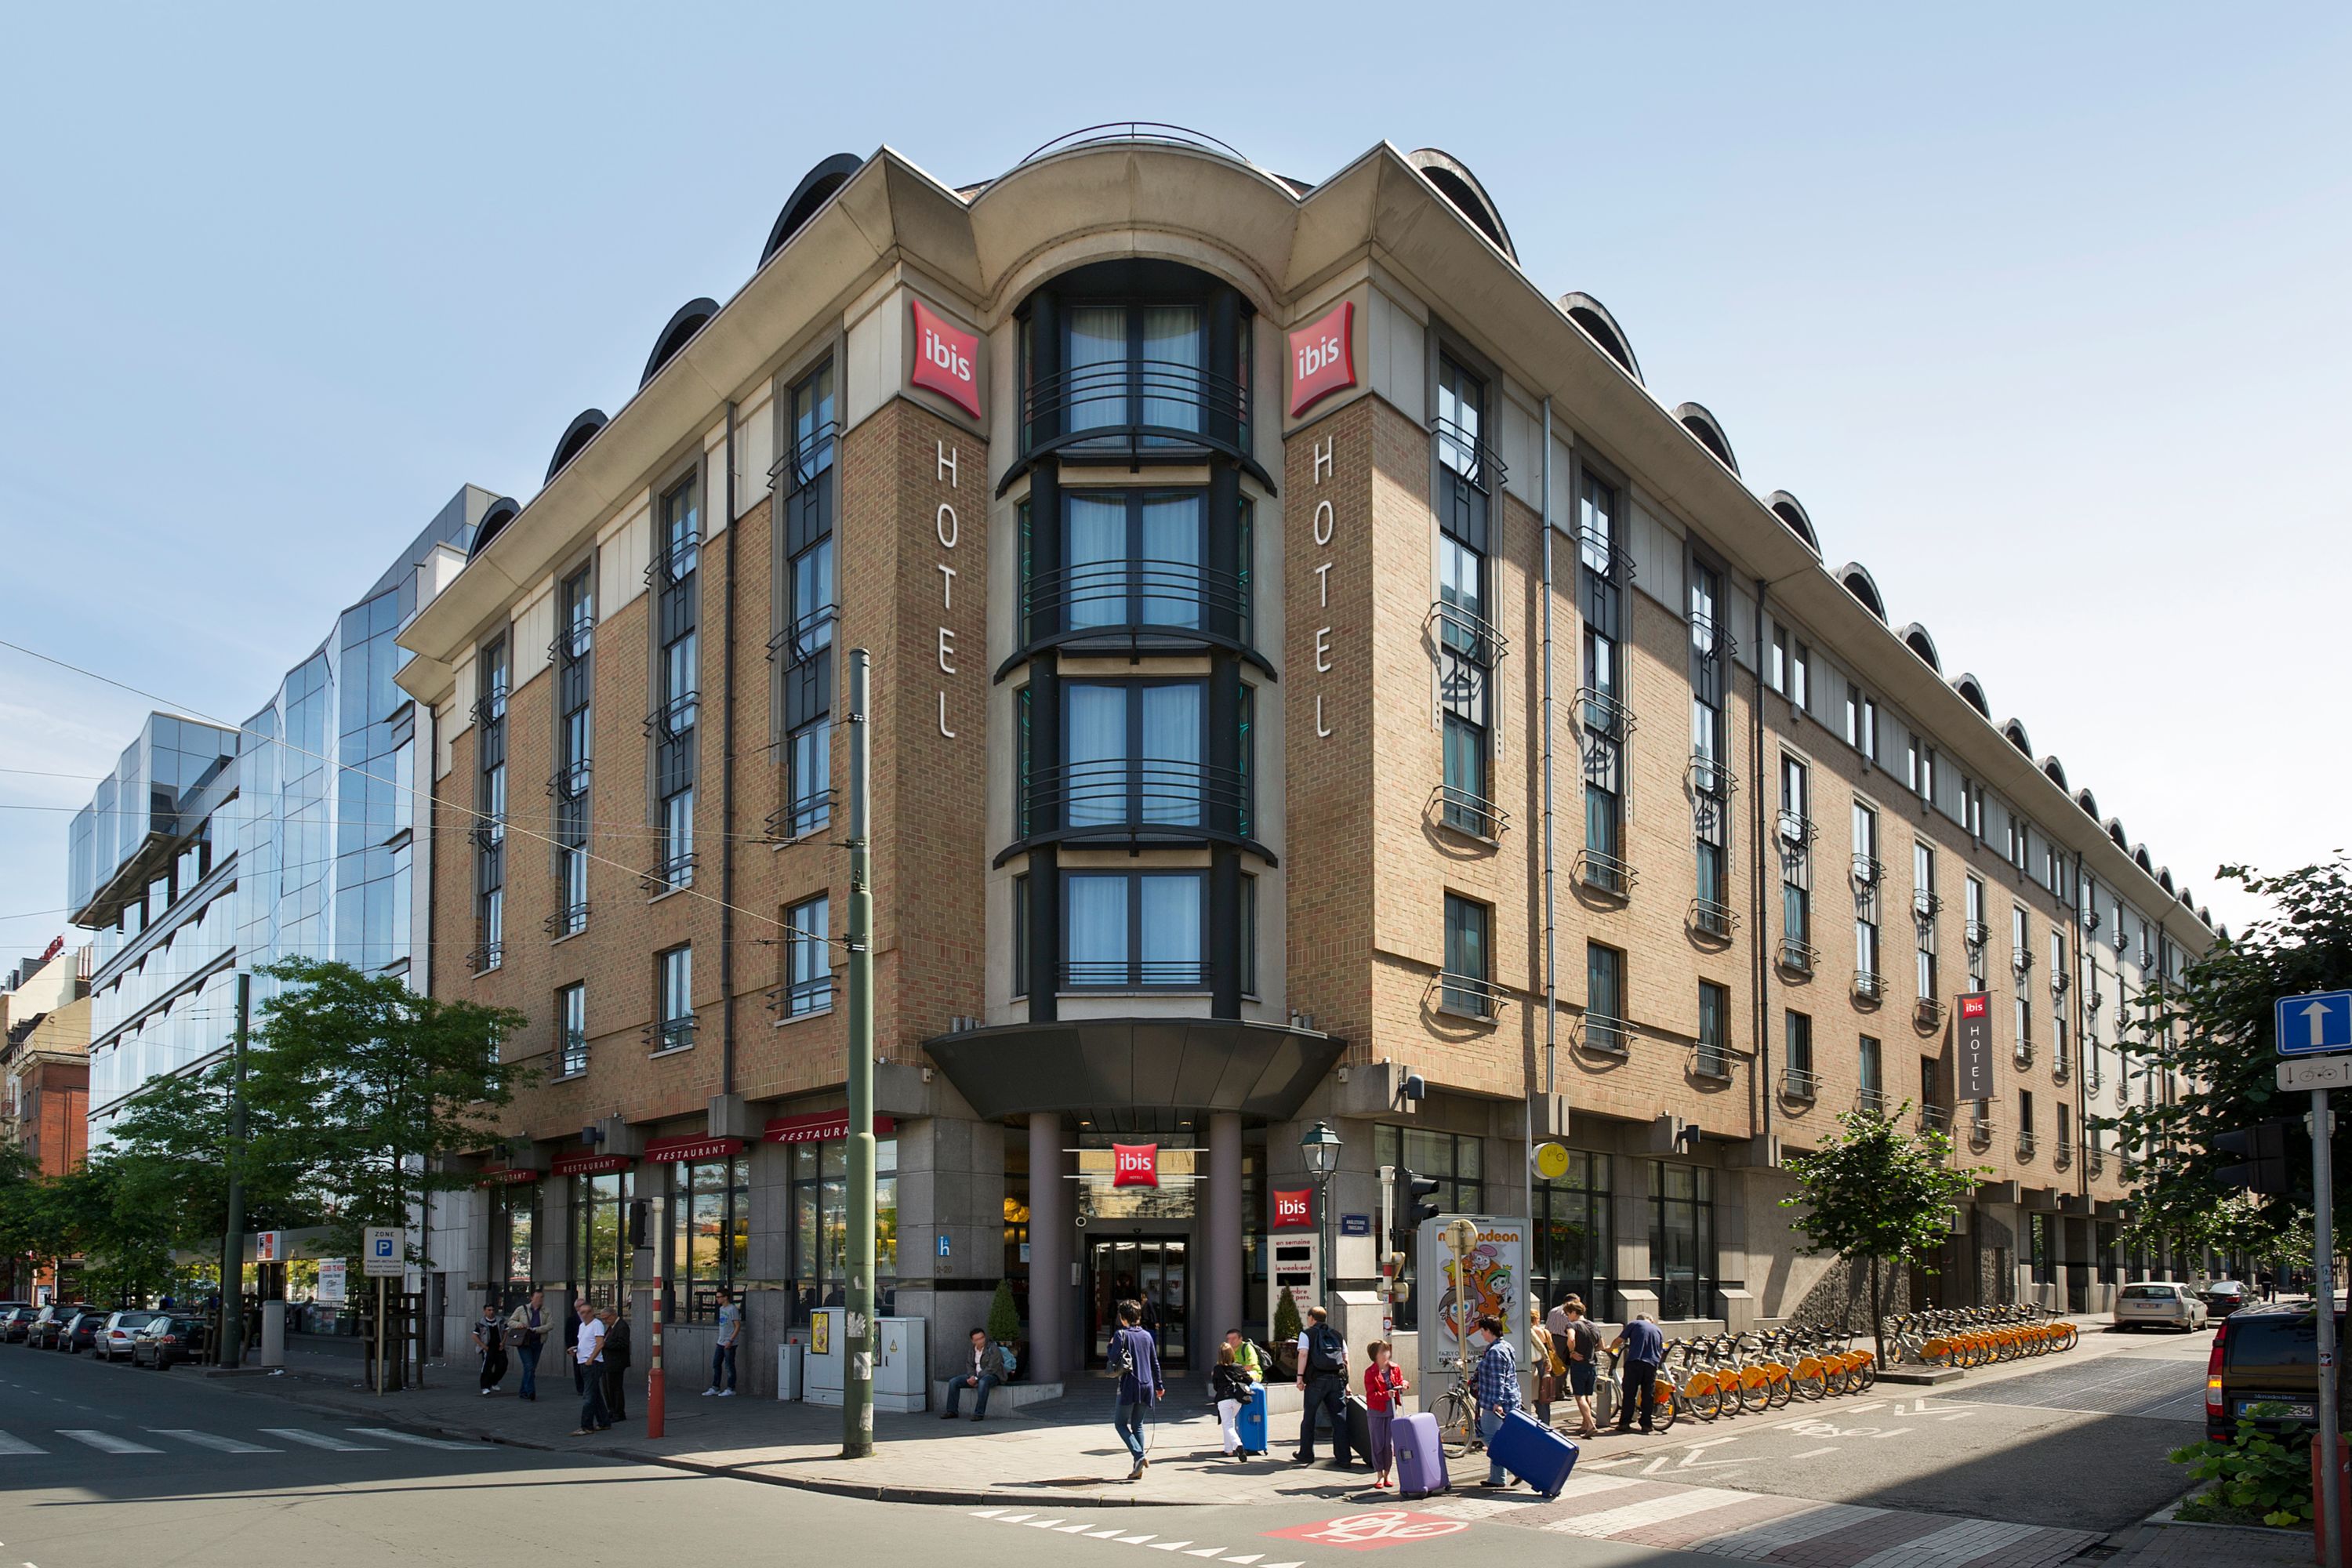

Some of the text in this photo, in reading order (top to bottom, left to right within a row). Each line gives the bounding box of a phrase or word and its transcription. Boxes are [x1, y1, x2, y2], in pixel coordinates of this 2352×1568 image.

[925, 328, 971, 382] ibis
[1298, 336, 1340, 380] ibis
[936, 439, 958, 739] HOTEL
[1314, 435, 1334, 738] HOTEL
[1965, 1003, 1984, 1013] ibis
[1970, 1025, 1981, 1091] HOTEL
[779, 1125, 849, 1142] RESTAURA
[656, 1145, 726, 1161] RESTAURANT
[563, 1160, 615, 1174] RESTAURANT
[1120, 1152, 1152, 1171] ibis
[1279, 1199, 1306, 1215] ibis
[1438, 1229, 1519, 1243] nodeon
[379, 1241, 390, 1255] P
[1282, 1262, 1312, 1271] week-end
